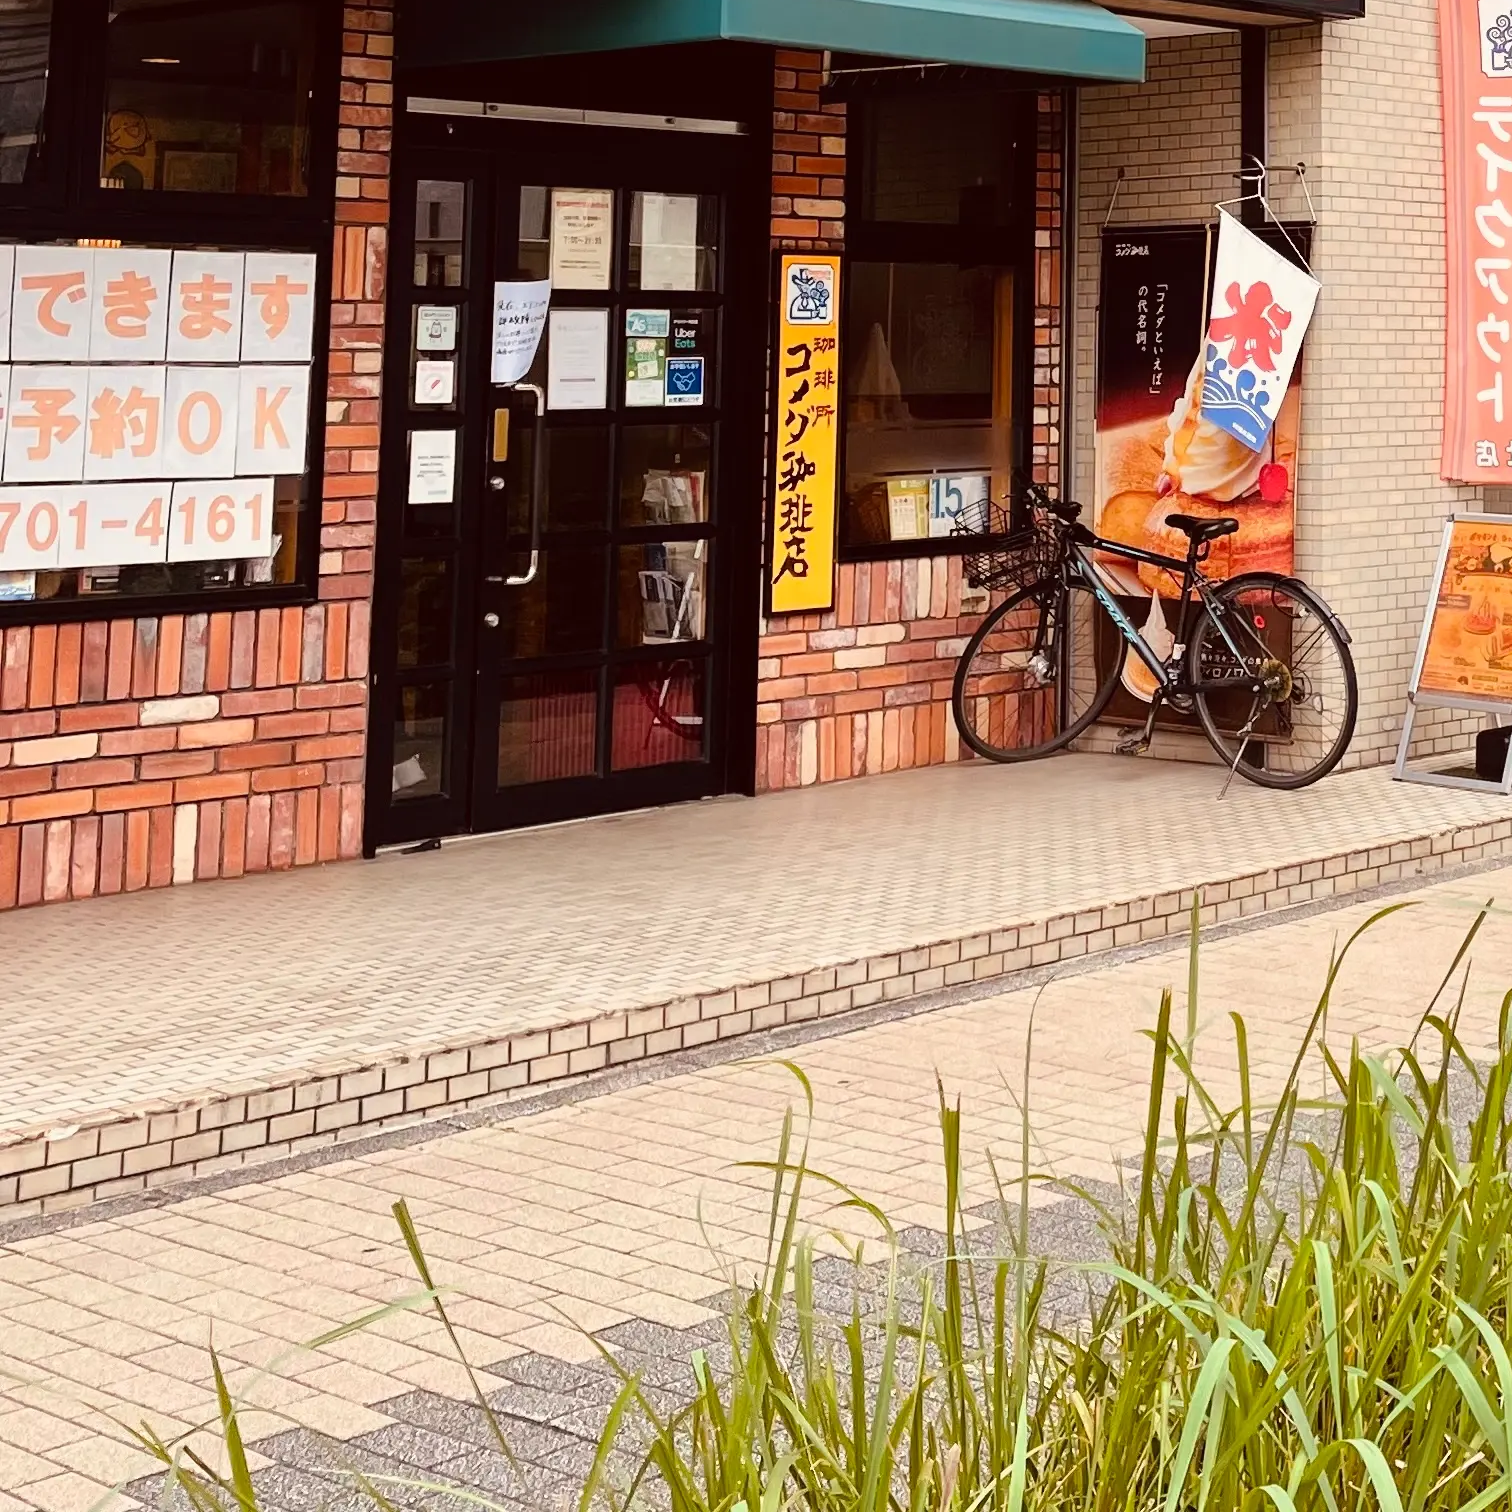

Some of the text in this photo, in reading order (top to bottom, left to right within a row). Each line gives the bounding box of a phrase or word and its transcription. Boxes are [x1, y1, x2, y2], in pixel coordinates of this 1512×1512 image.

[21, 271, 308, 339] できます
[0, 386, 292, 461] 予約OK
[771, 344, 815, 585] コメダ珈琲店
